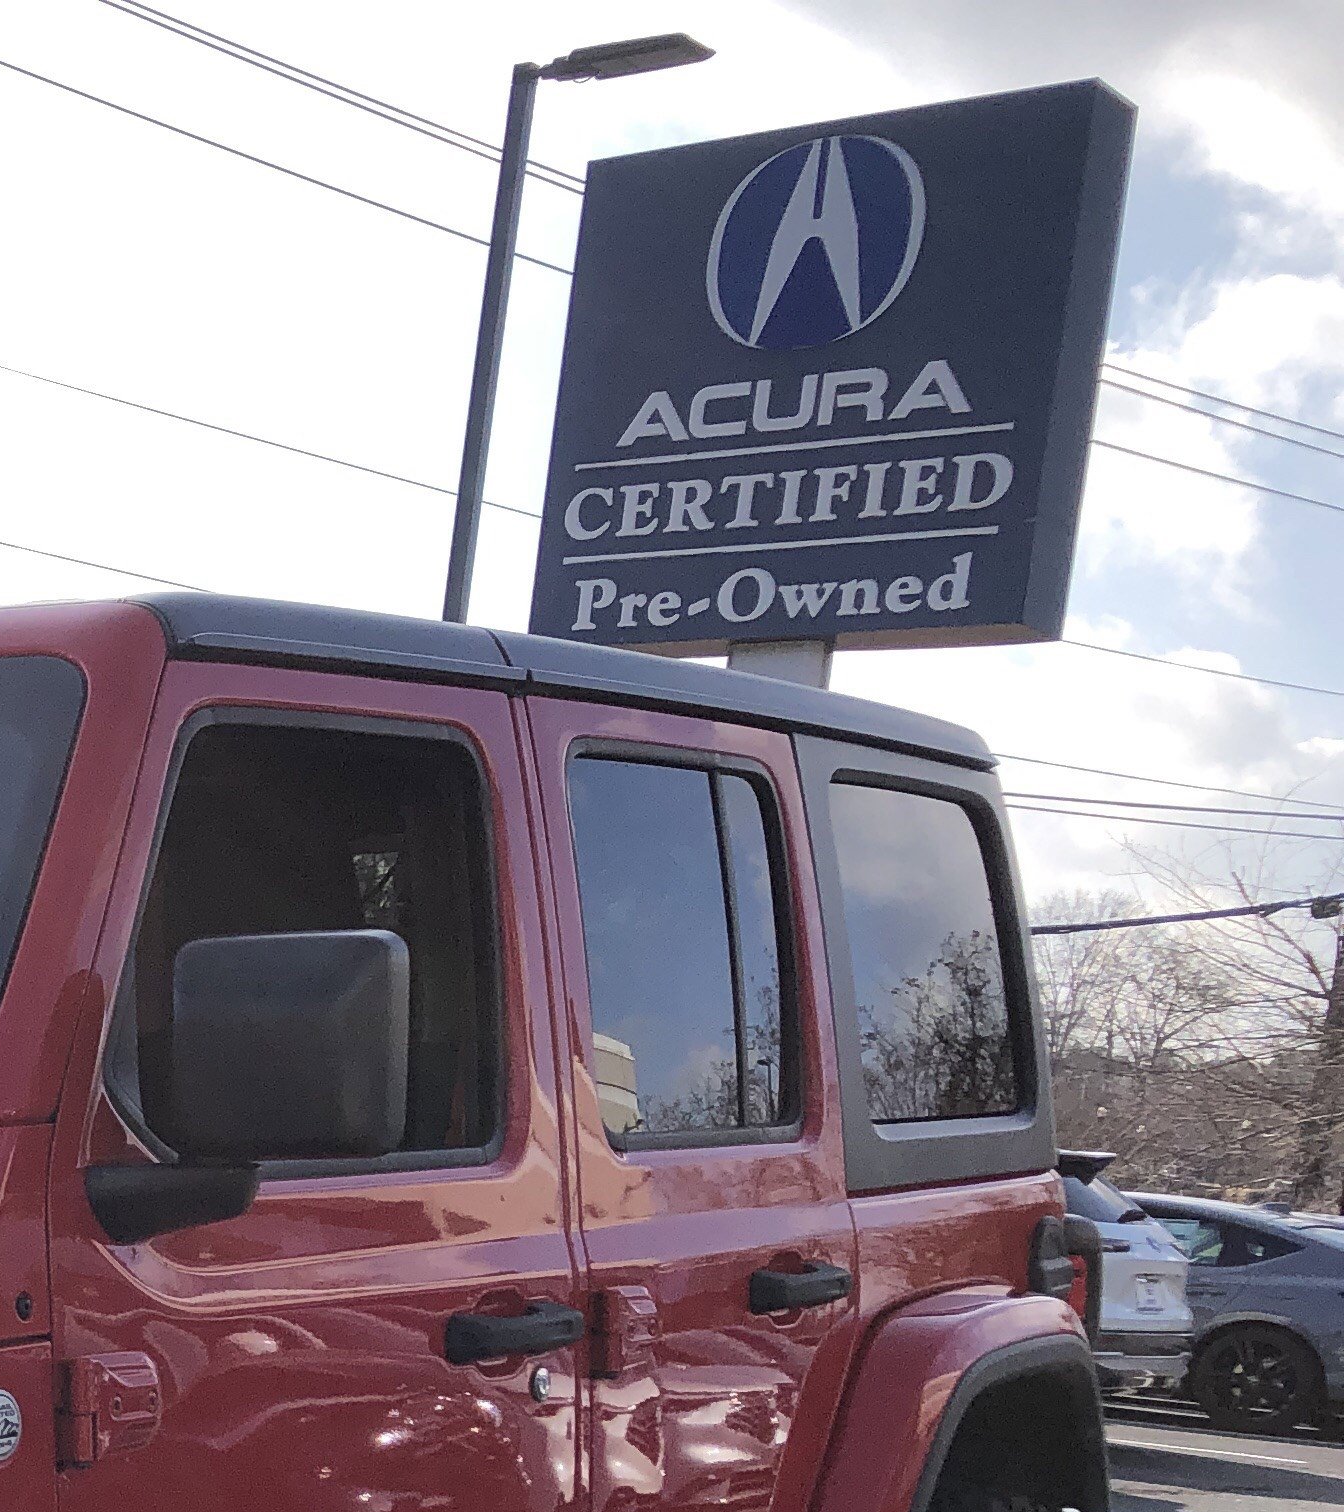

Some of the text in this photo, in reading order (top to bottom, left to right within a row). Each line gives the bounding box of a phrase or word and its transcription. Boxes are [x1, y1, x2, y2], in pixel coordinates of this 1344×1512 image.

[616, 360, 972, 447] ACURA
[564, 453, 1014, 541] CERTIFIED
[571, 551, 973, 631] Pre-Owned
